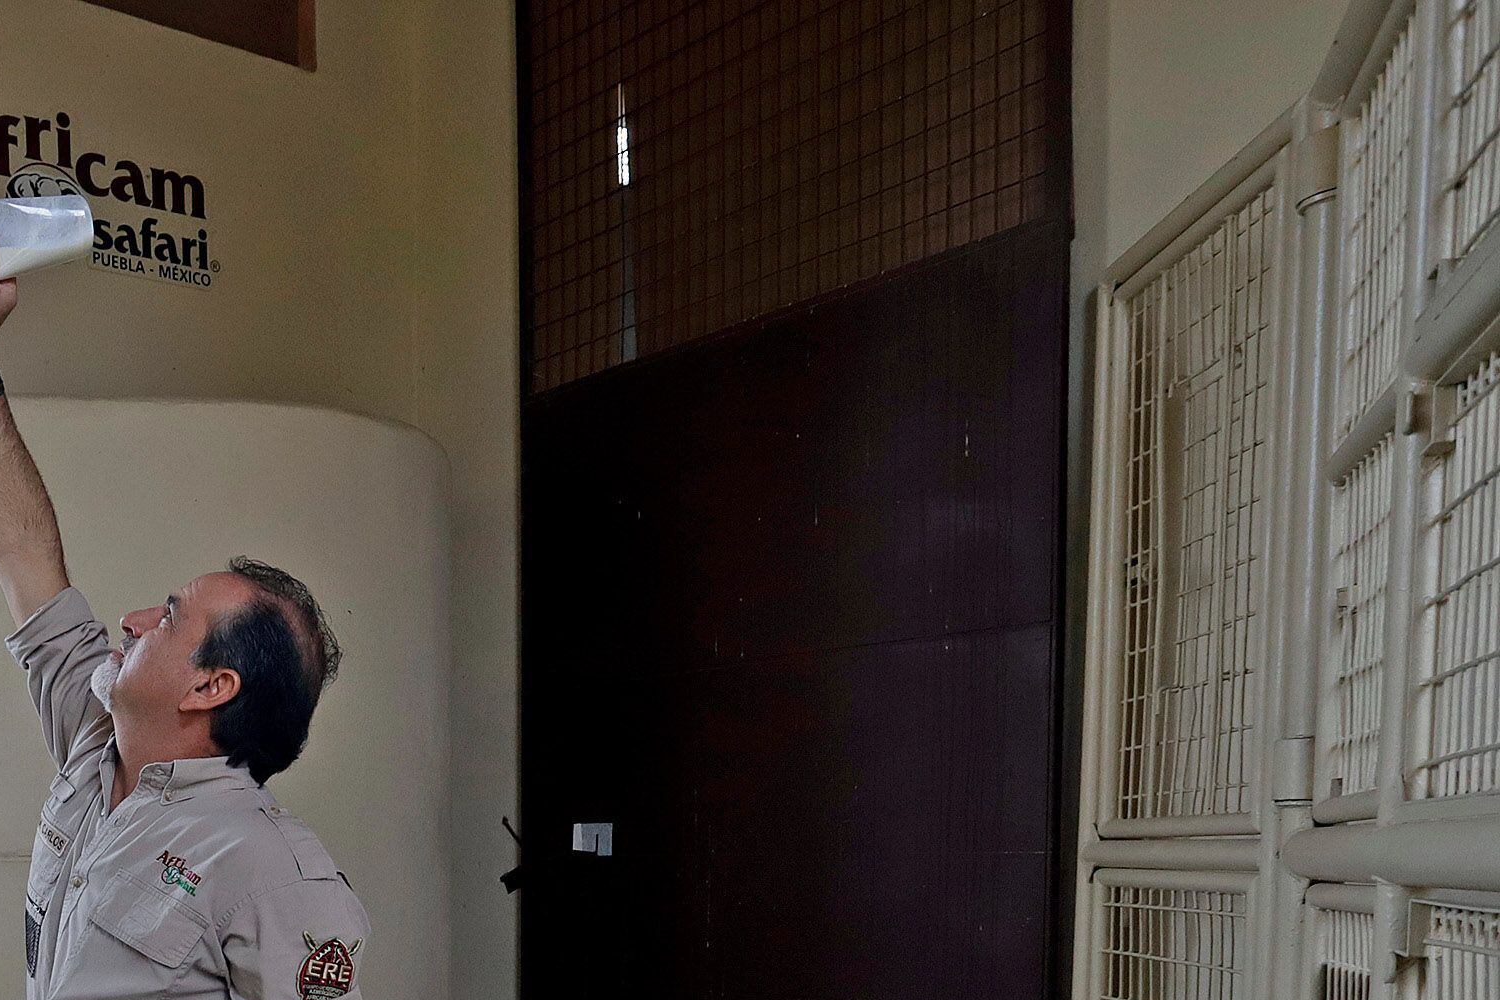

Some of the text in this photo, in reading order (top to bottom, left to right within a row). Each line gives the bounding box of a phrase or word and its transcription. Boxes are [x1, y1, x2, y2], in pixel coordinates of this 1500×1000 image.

[92, 251, 146, 275] PUEBLA
[158, 264, 211, 287] MÉXICO
[308, 959, 352, 983] ERE
